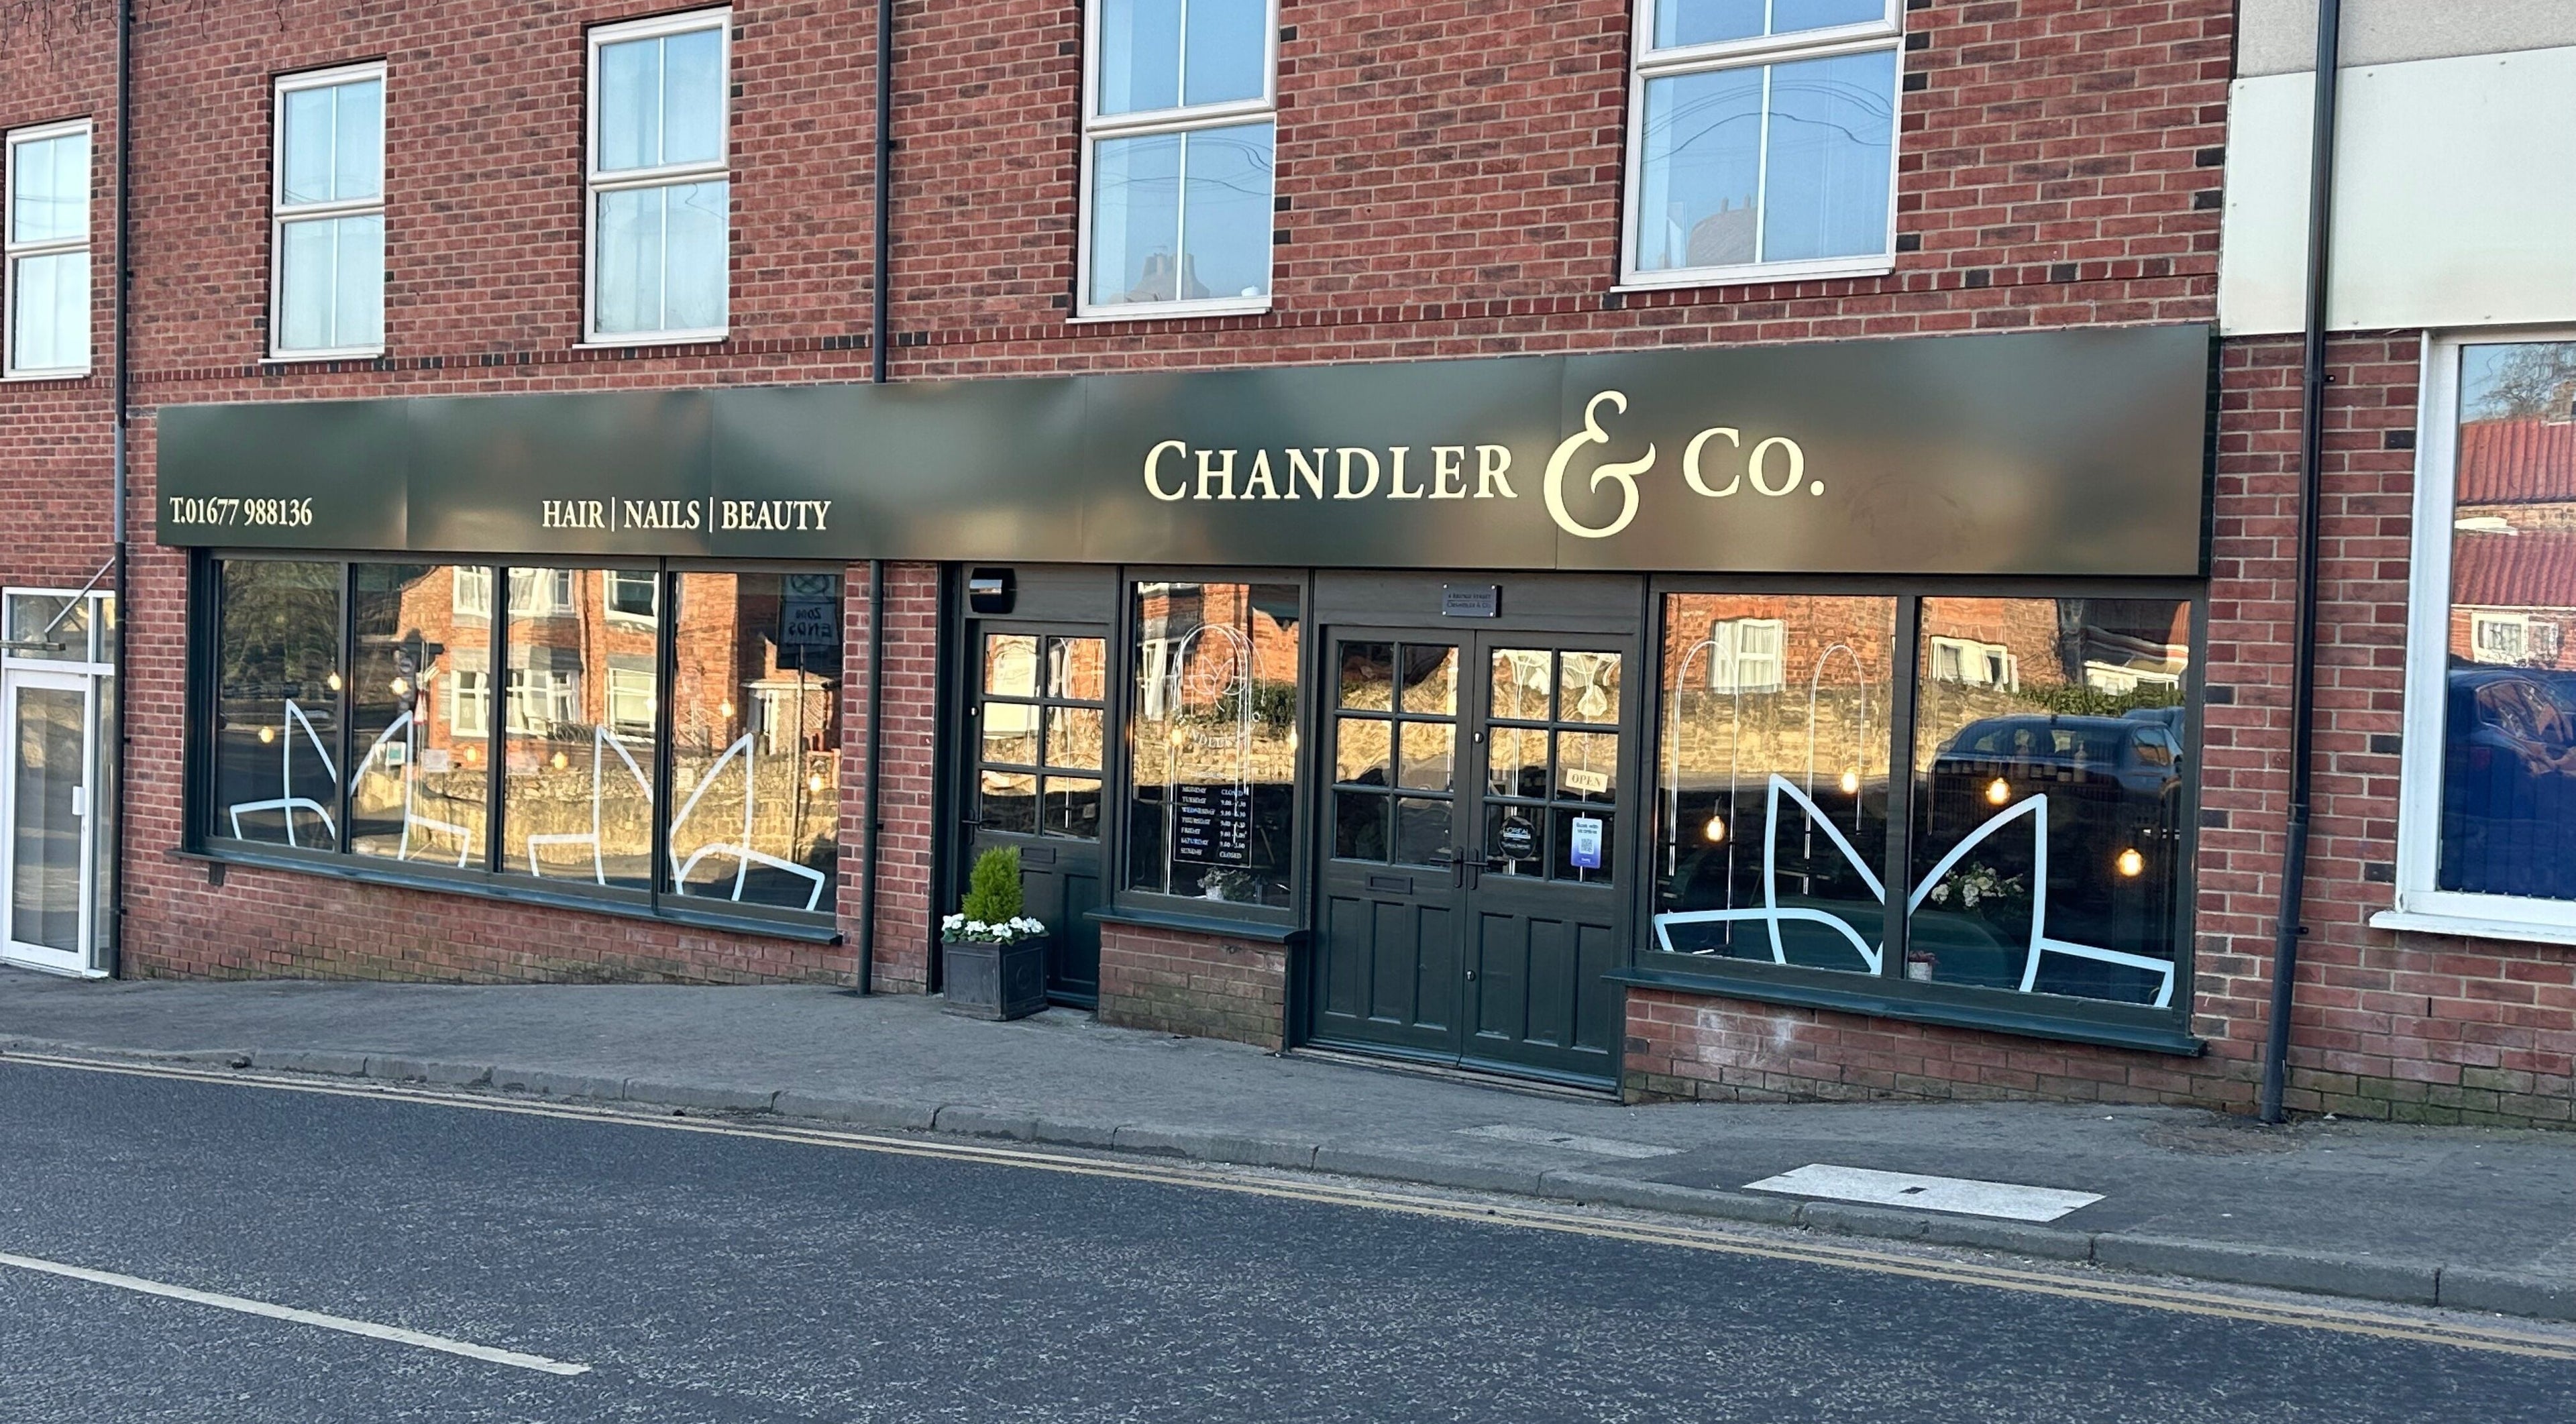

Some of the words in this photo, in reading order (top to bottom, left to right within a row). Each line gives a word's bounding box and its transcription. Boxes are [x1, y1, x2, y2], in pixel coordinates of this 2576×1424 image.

[1542, 389, 1657, 539] &
[169, 496, 239, 526] T.01677
[244, 498, 313, 527] 988136
[541, 500, 606, 529] HAIR
[623, 500, 700, 530] NAILS
[720, 500, 833, 531] BEAUTY
[1572, 773, 1601, 787] OPEN
